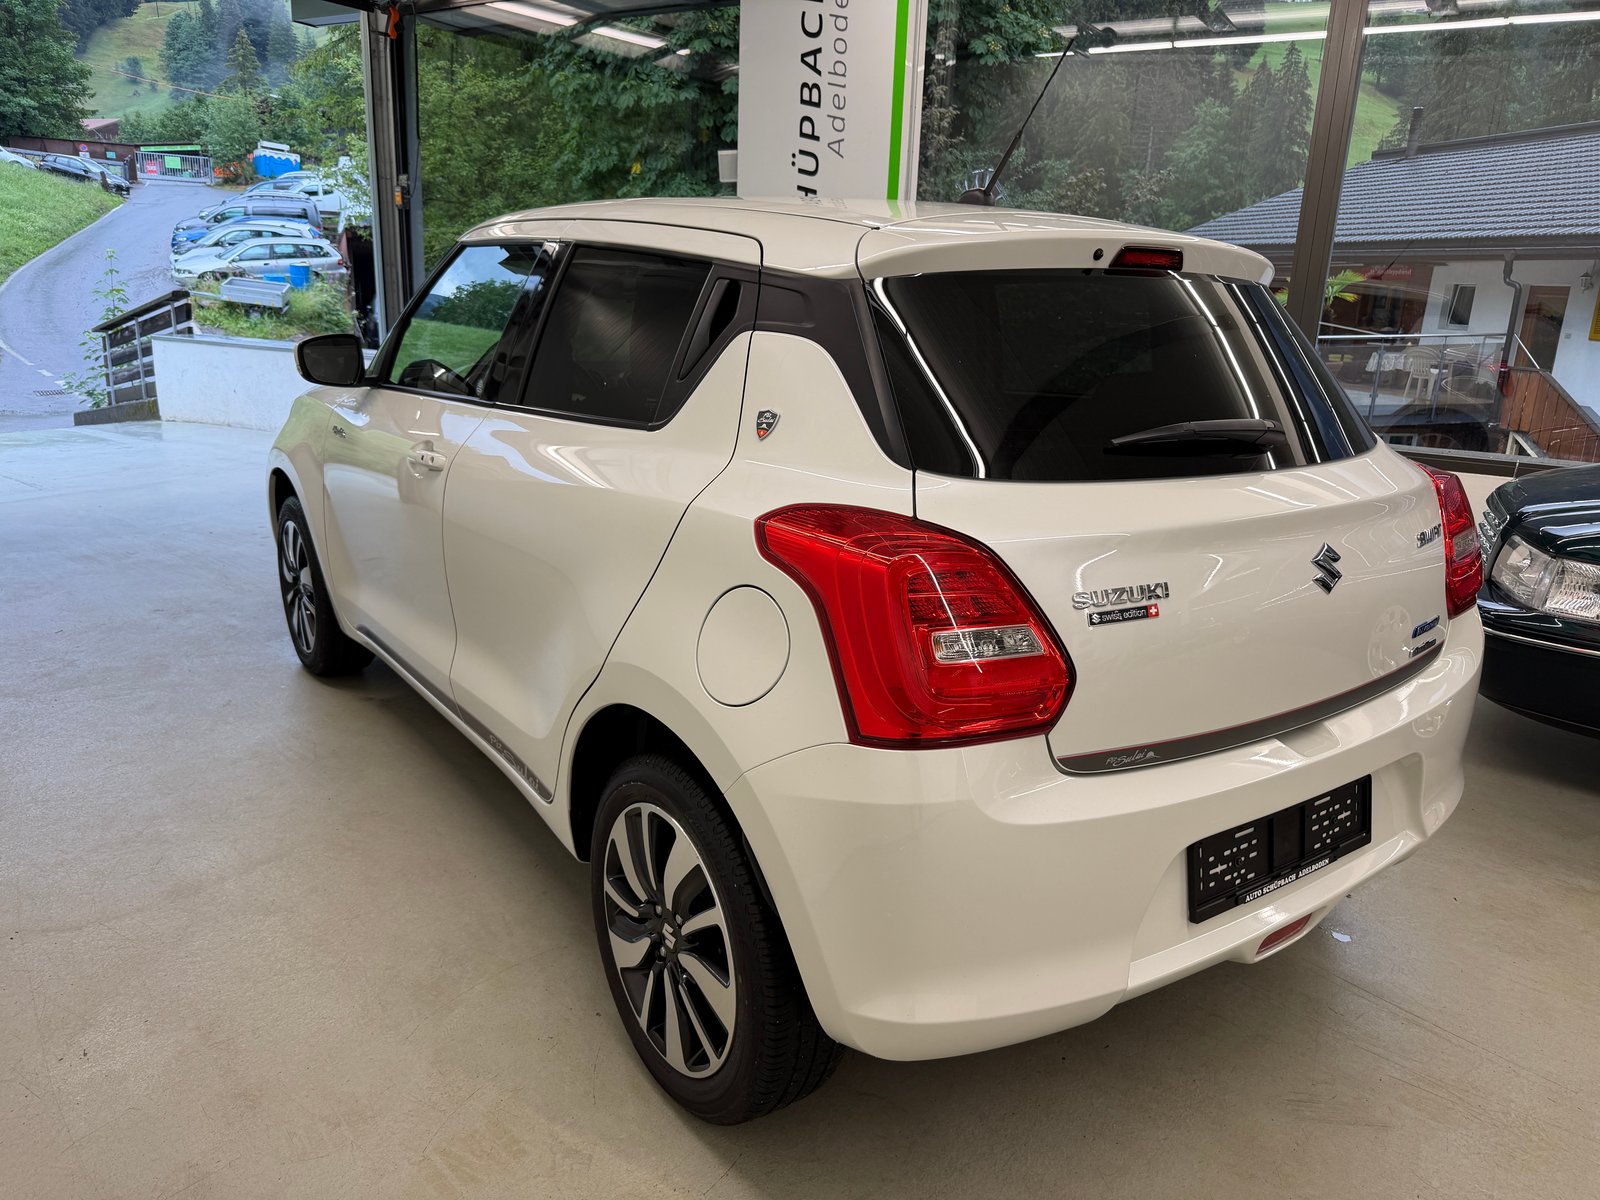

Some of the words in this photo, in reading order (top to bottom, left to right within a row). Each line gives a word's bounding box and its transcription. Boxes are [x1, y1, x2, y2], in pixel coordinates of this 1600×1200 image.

[791, 0, 824, 197] ÜPBAC
[1071, 581, 1170, 611] SUZUKI
[1101, 610, 1123, 622] swiss
[1123, 607, 1147, 619] edition
[1245, 889, 1262, 903] AUTO
[1262, 873, 1297, 895] SCHÜPBACH
[1298, 857, 1330, 878] ADELBODEN
